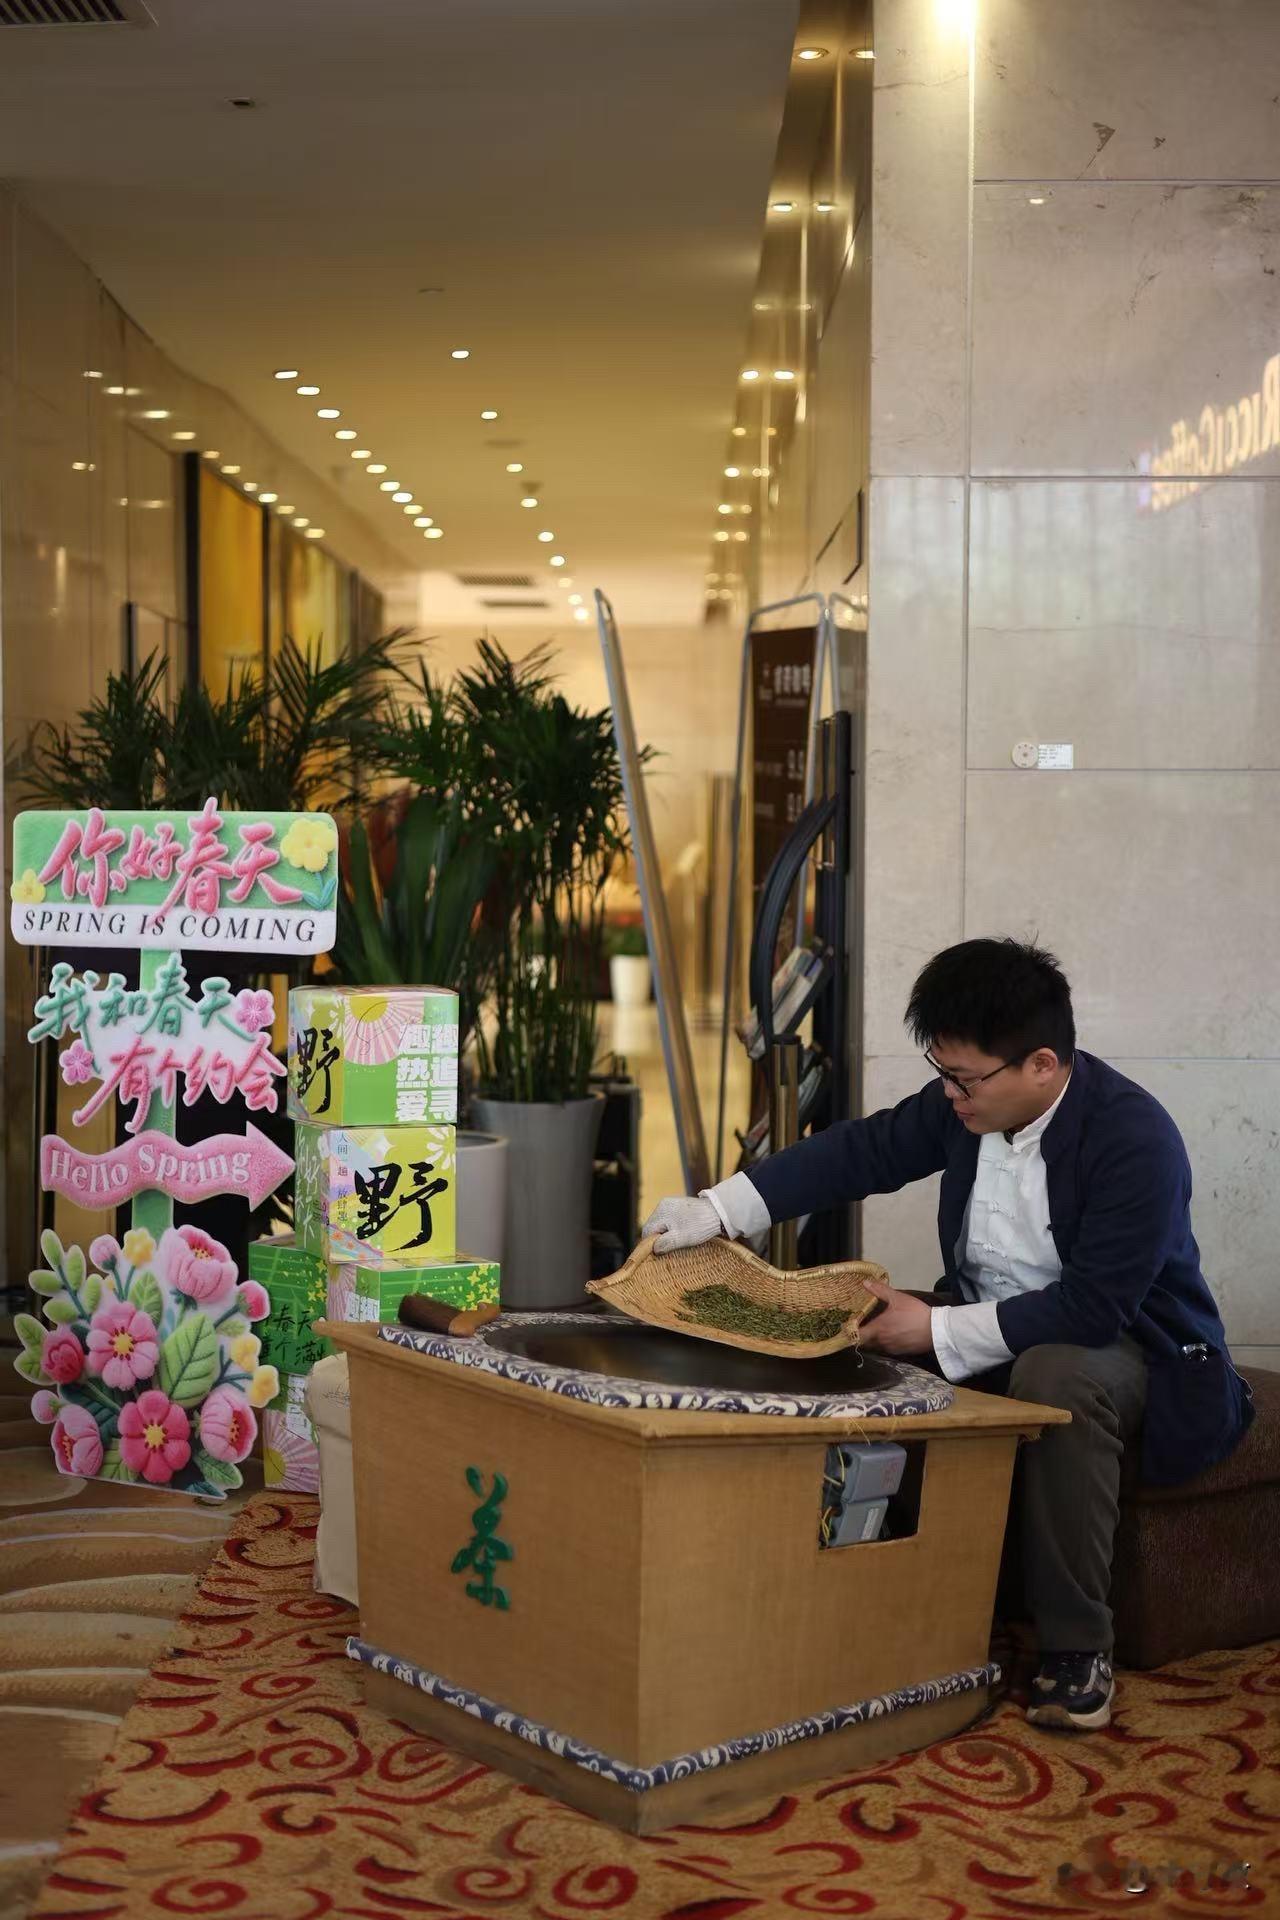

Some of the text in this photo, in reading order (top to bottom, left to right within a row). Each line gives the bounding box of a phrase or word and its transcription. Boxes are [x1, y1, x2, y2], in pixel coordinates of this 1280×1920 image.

[37, 797, 304, 926] 你好春天
[23, 911, 317, 943] SPRING IS COMING
[28, 953, 256, 1072] 我和春天
[73, 1034, 287, 1132] 有个约会
[296, 1027, 341, 1115] 野
[49, 1147, 252, 1193] Hello Spring
[354, 1162, 449, 1253] 野
